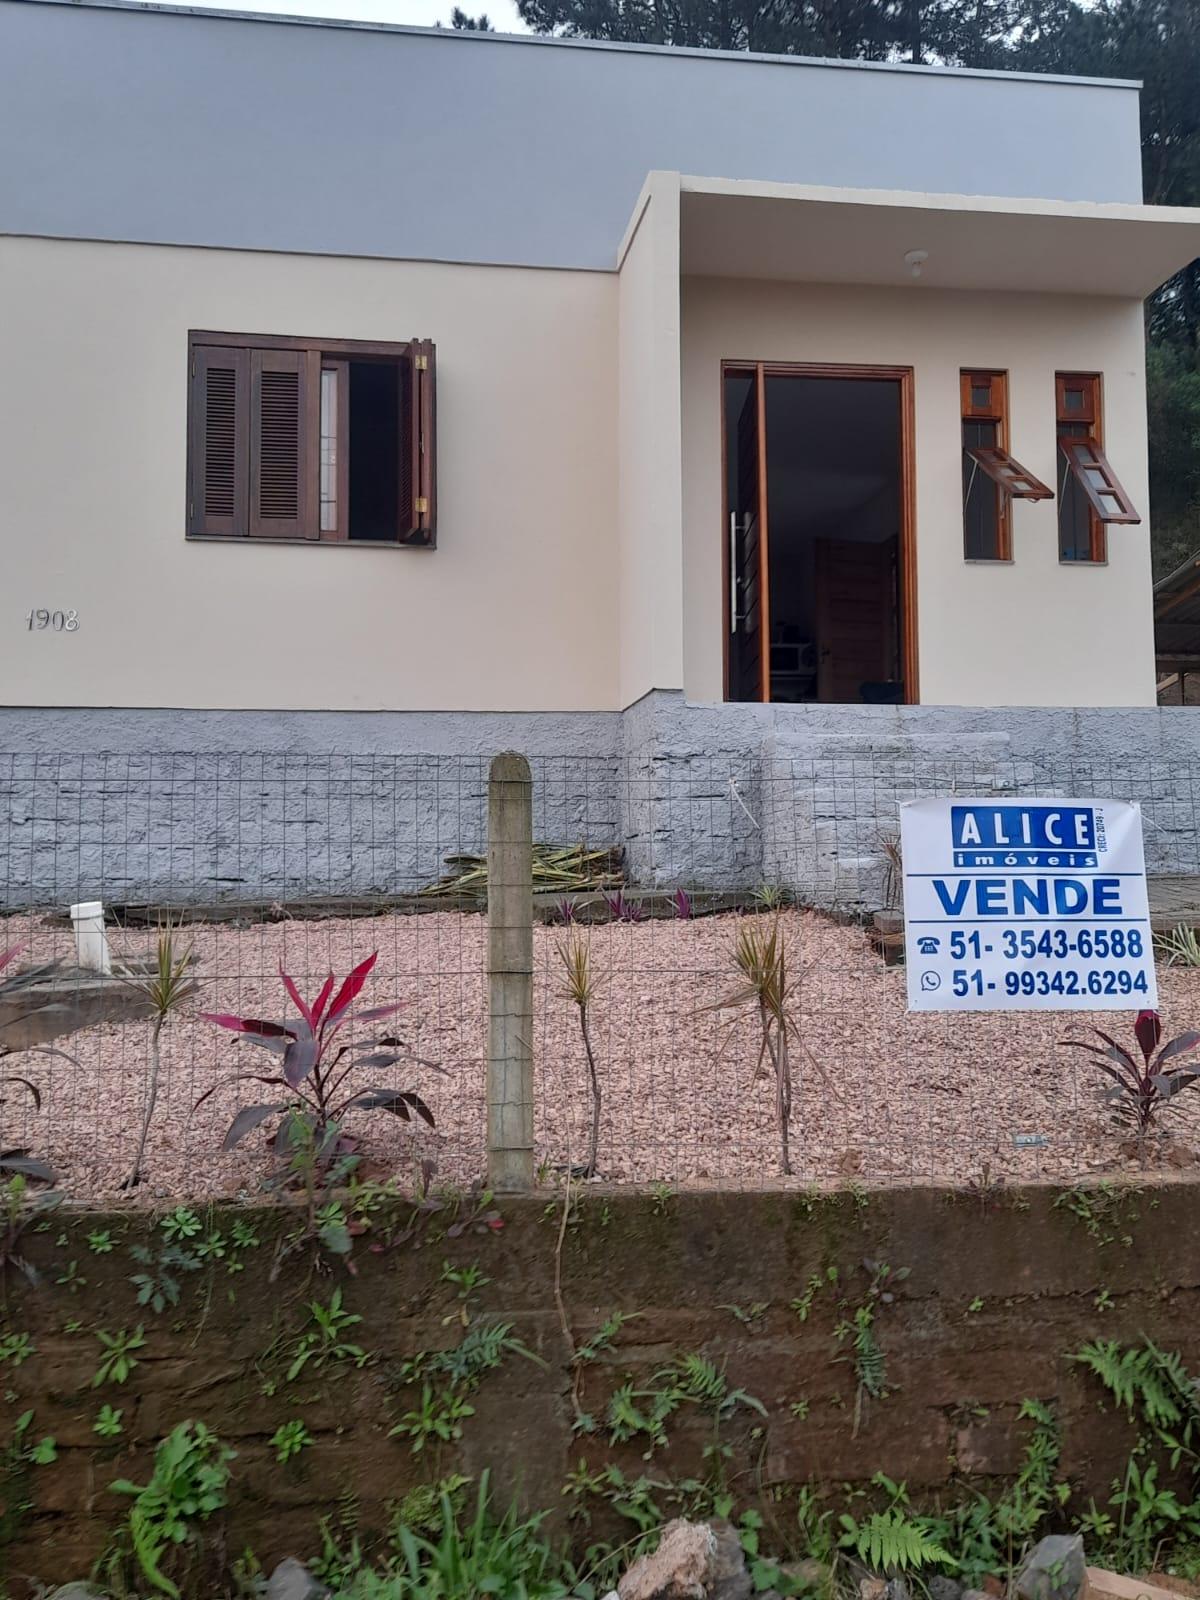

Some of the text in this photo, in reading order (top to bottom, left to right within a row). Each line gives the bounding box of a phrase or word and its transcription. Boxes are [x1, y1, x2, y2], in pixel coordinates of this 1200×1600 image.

[25, 608, 80, 632] 1908
[961, 812, 1090, 846] ALICE
[957, 853, 1096, 867] imóveis
[932, 879, 1123, 916] VENDE
[950, 929, 1144, 960] 51- 3543-6588
[952, 969, 1148, 997] 51- 99342.6294
